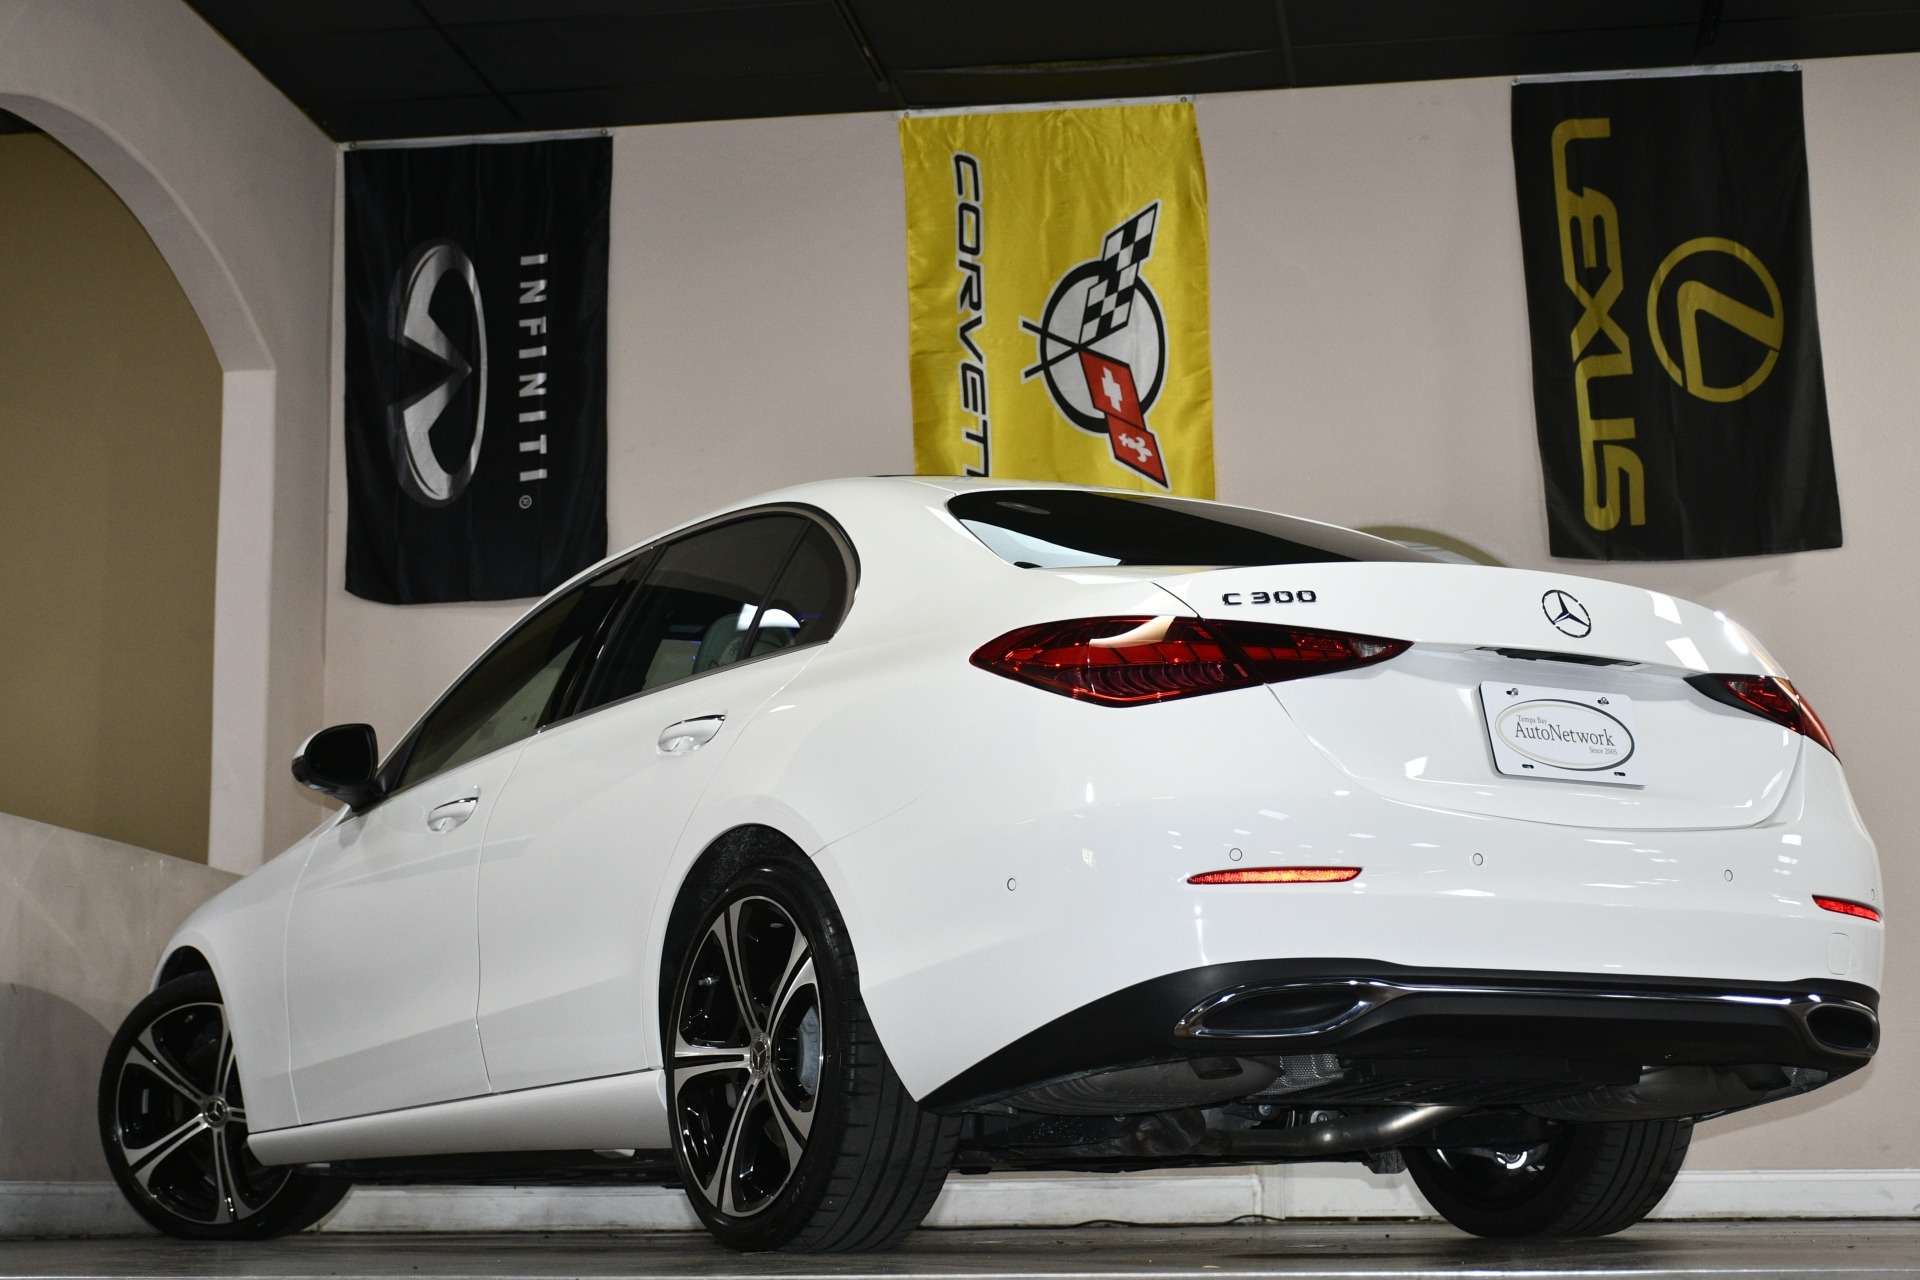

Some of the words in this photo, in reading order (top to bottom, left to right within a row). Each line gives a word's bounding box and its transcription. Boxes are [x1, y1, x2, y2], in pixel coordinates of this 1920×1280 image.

[519, 253, 548, 482] INFINITI
[953, 152, 991, 477] CORVETT
[1551, 117, 1646, 531] LEXUS
[1222, 592, 1242, 605] C
[1250, 590, 1317, 604] 300
[1515, 721, 1615, 746] AutoNetwork
[1516, 715, 1536, 724] Tampa
[1536, 716, 1547, 725] Bay
